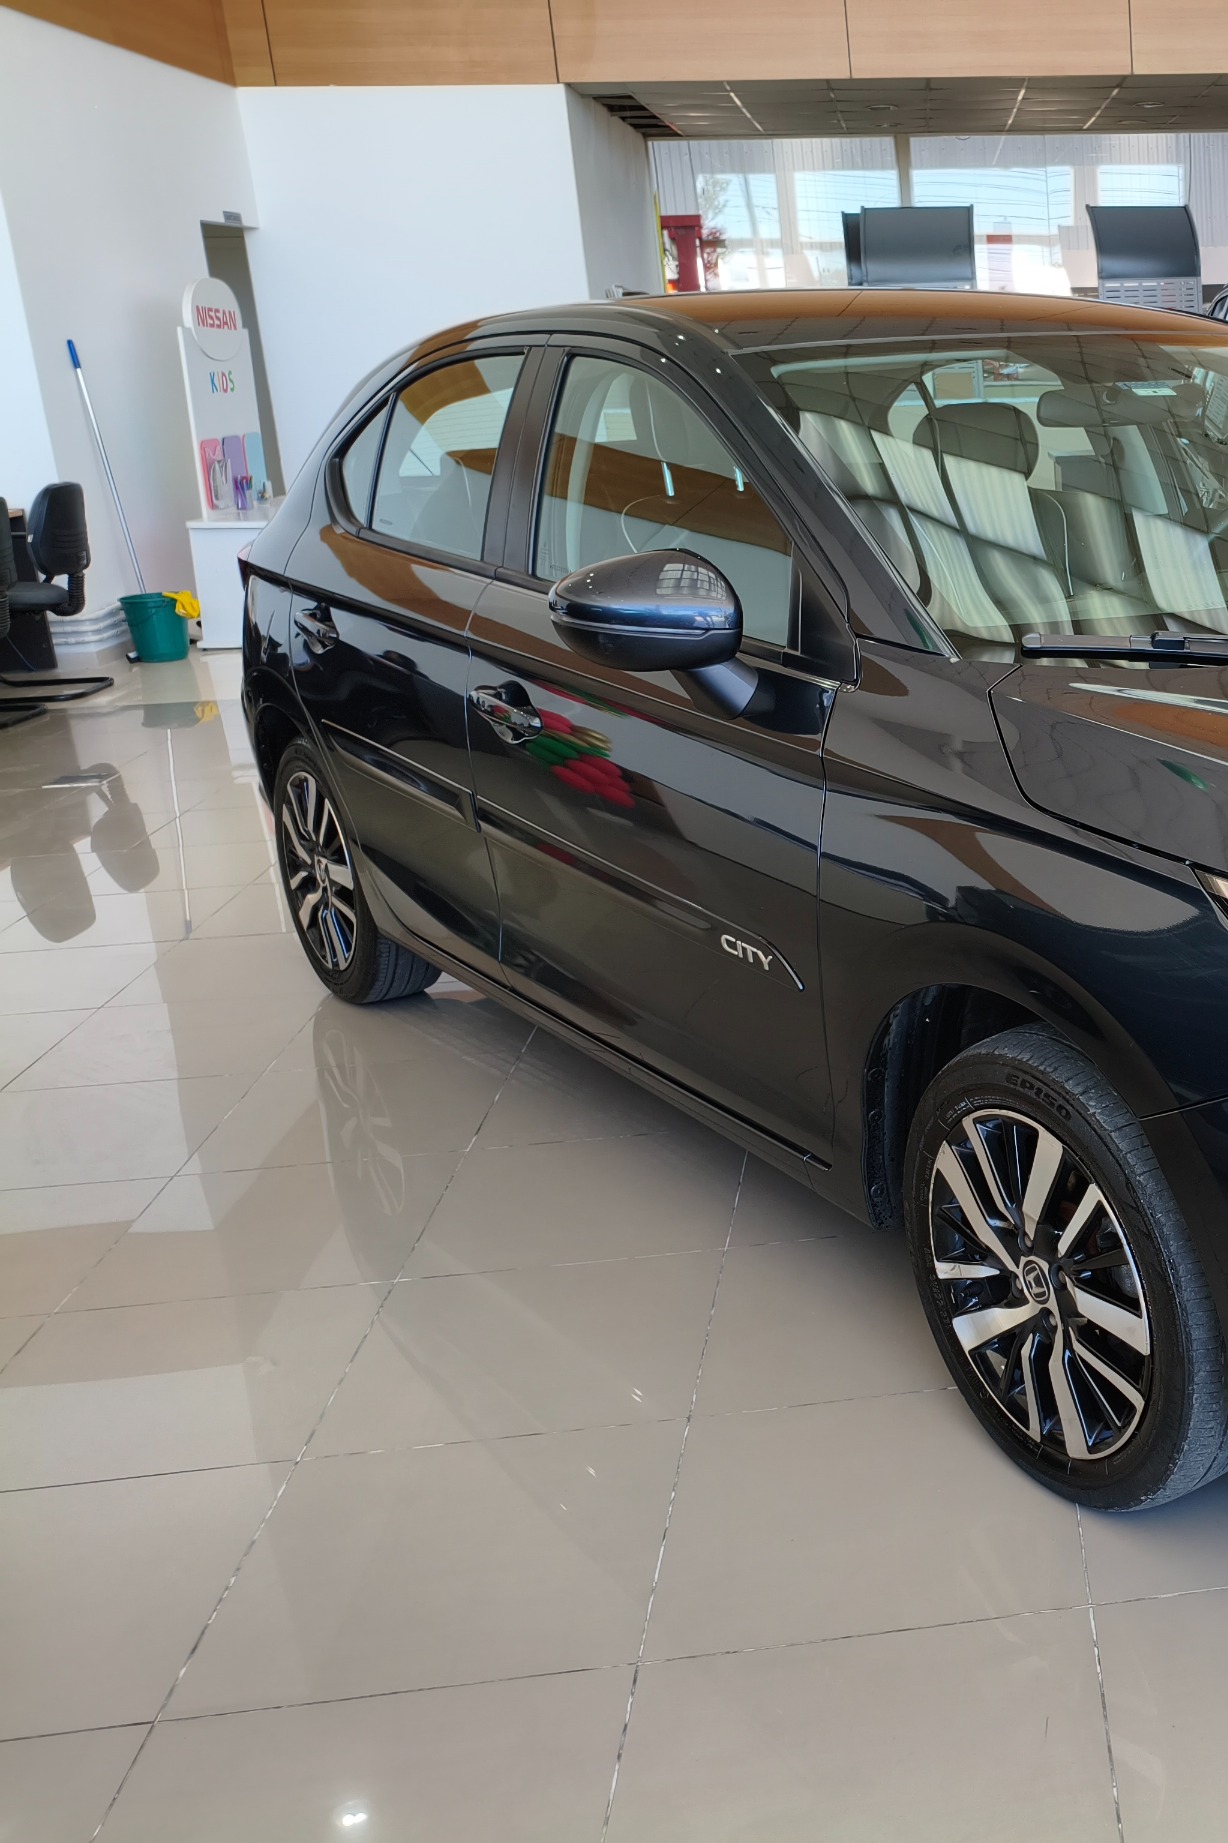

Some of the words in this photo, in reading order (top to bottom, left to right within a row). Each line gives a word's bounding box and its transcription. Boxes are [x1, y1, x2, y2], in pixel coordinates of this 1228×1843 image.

[196, 305, 238, 331] NISSAN
[209, 370, 236, 394] KIDS
[721, 934, 773, 971] CITY
